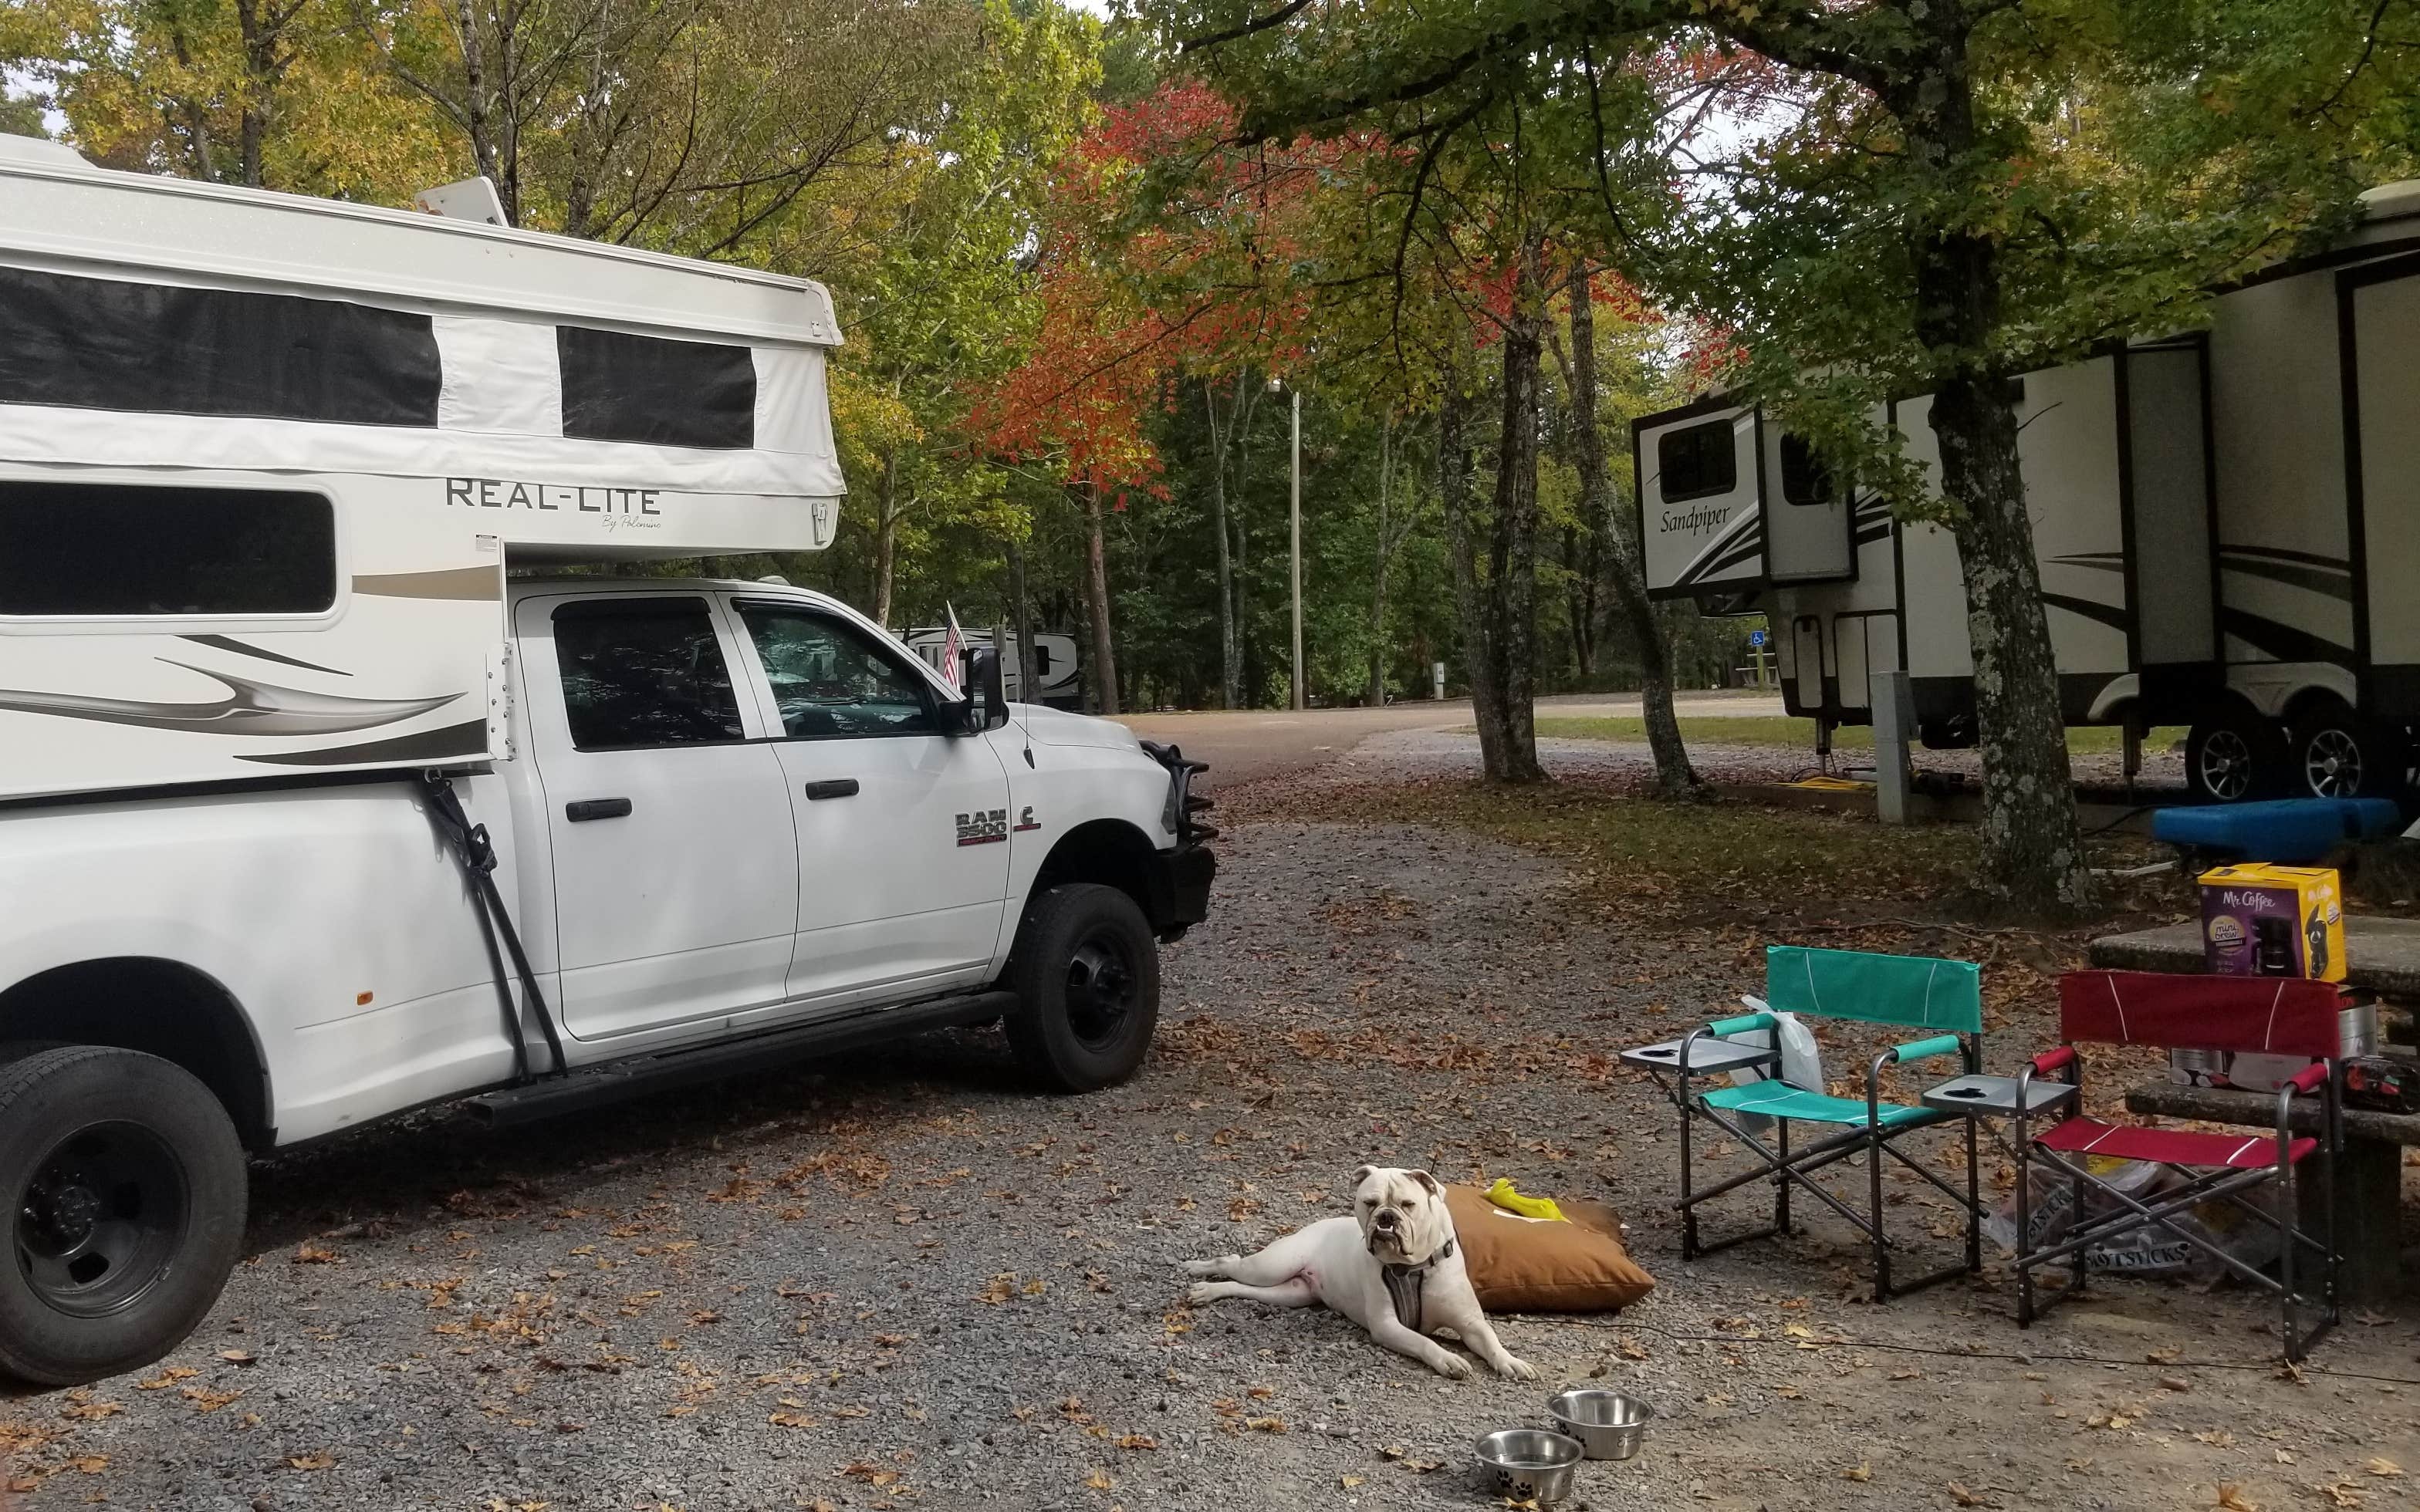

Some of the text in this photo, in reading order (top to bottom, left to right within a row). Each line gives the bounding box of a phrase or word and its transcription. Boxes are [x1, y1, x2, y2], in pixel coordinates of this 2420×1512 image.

[446, 477, 661, 515] REAL-LITE
[602, 515, 617, 532] By
[1661, 505, 1730, 537] Sandpiper
[955, 808, 1006, 826] RAM
[2243, 891, 2276, 912] Coffee
[2216, 923, 2236, 933] mini
